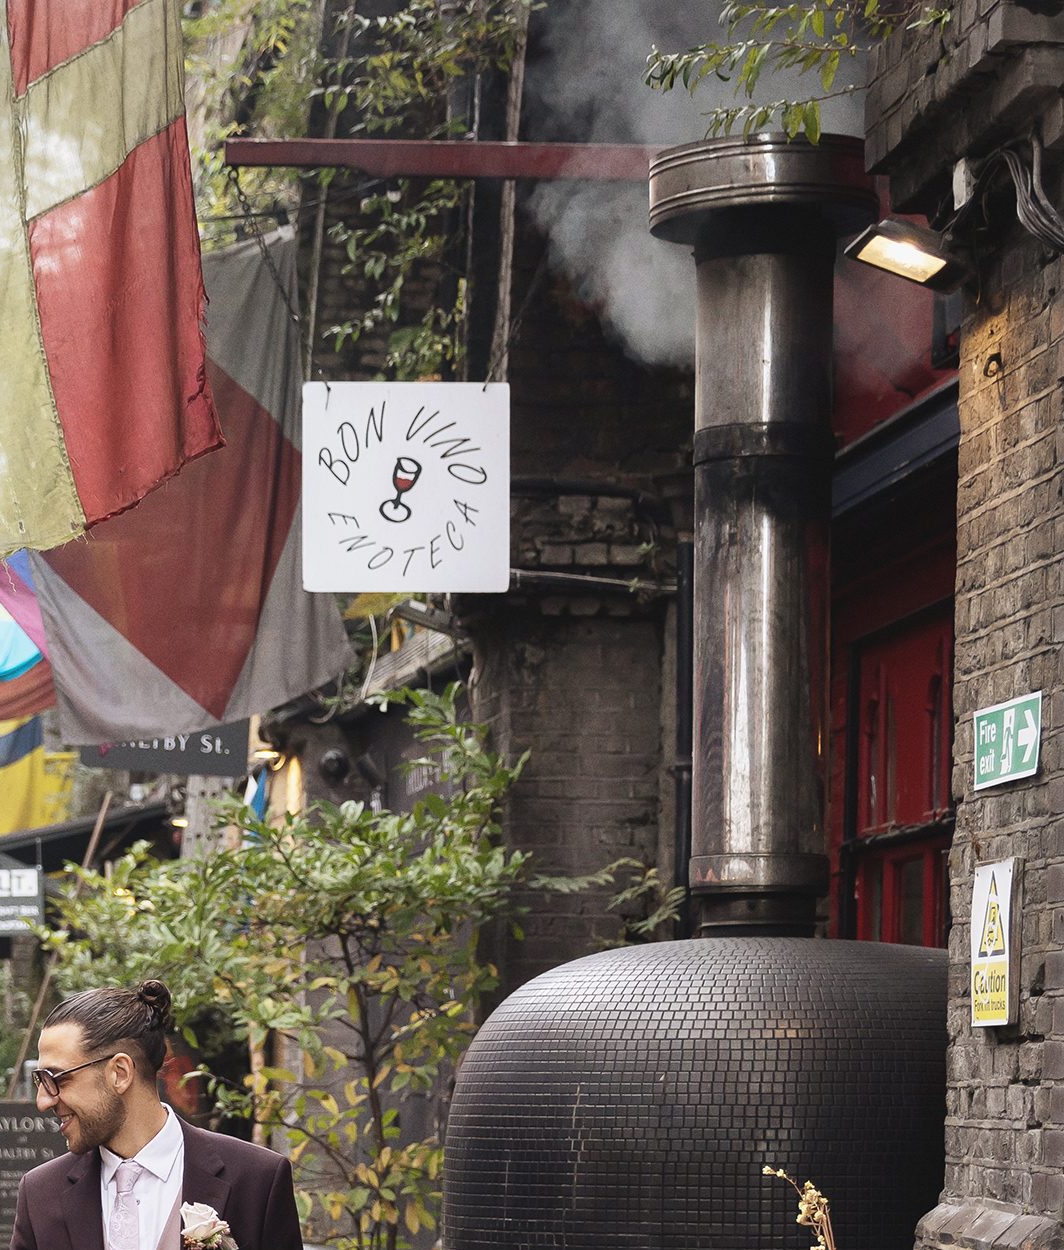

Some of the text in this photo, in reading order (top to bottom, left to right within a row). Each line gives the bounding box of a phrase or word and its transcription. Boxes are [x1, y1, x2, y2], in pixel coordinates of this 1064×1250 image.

[319, 401, 487, 485] BON VINO
[327, 499, 479, 576] ENOTECA
[979, 720, 996, 745] Fire
[979, 749, 995, 775] exit
[974, 970, 1006, 995] Caution
